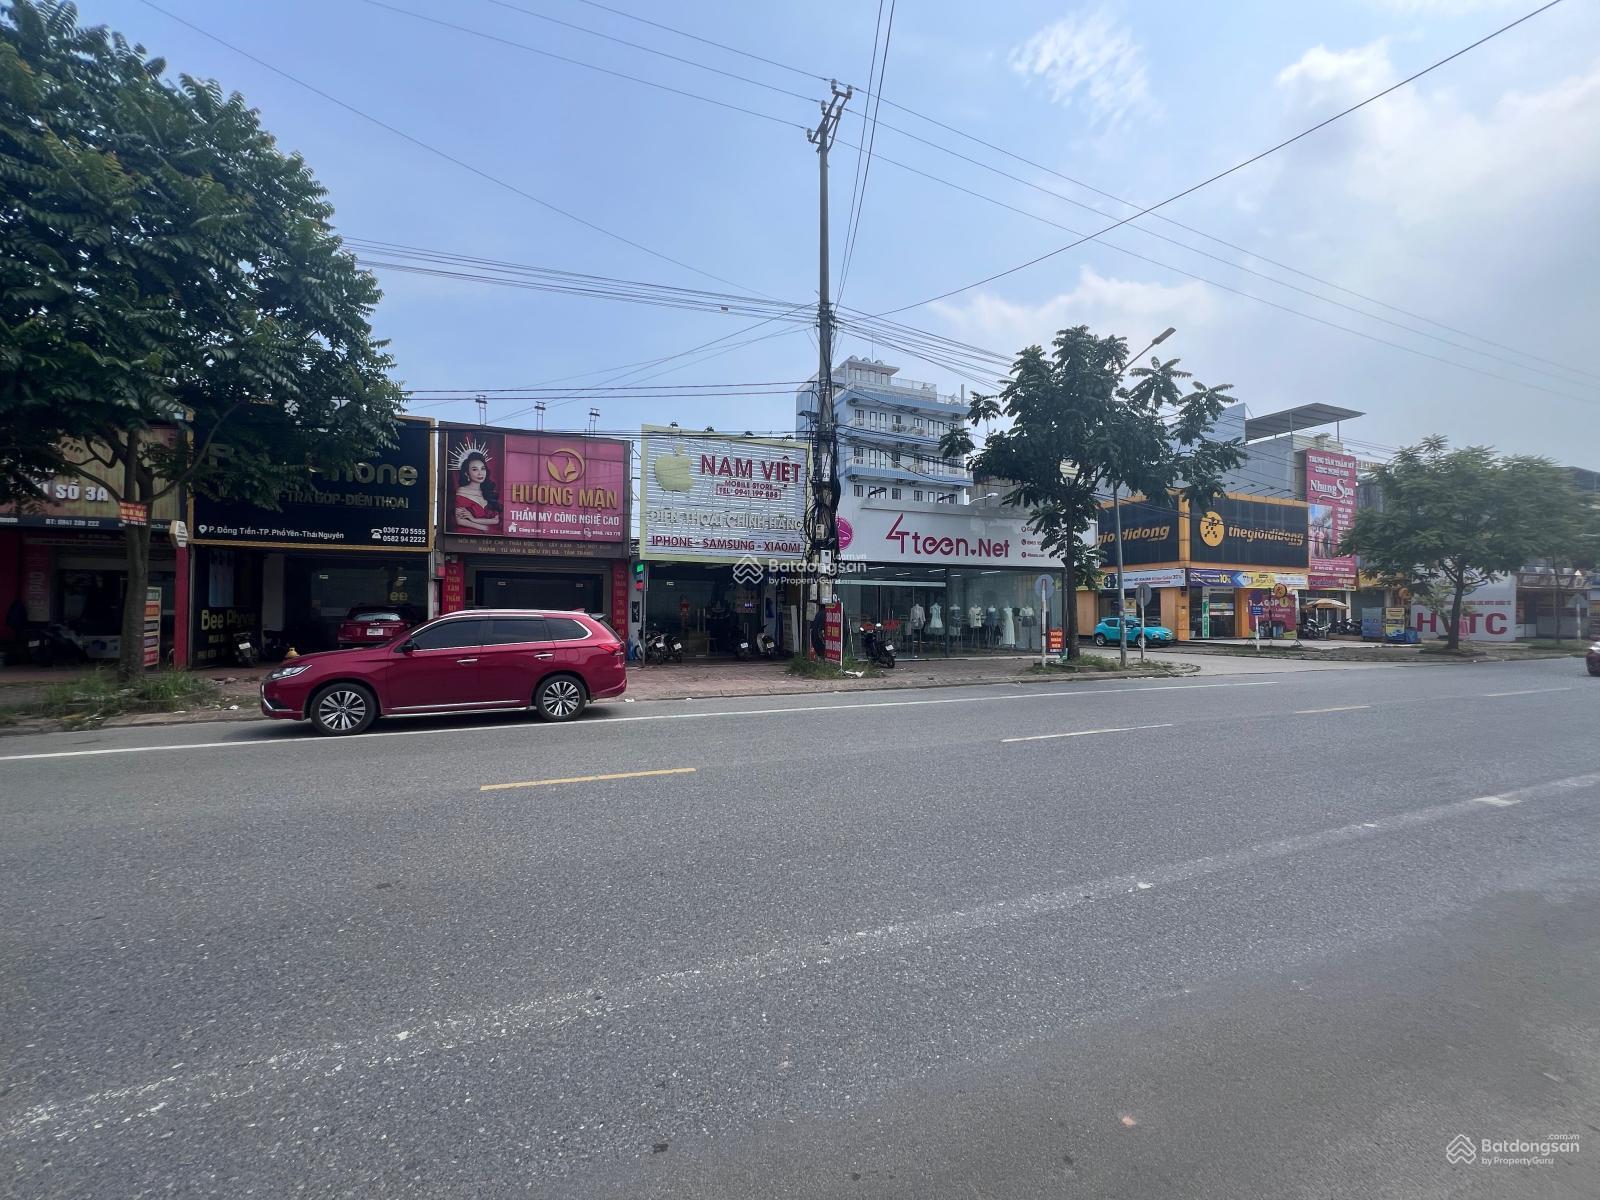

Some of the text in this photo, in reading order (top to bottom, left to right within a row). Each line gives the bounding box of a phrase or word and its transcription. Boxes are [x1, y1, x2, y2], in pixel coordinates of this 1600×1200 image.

[701, 455, 801, 487] NAM VIỆT
[55, 479, 80, 499] SỐ
[86, 486, 109, 501] 3A
[511, 483, 618, 511] HƯƠNG MẬN
[1311, 479, 1354, 499] Nhung Spa
[511, 507, 536, 522] THẨM
[554, 512, 577, 524] CÔNG
[579, 512, 601, 527] NGHỆ
[602, 516, 620, 526] CAO
[652, 535, 693, 547] IPHONE
[703, 538, 755, 550] SAMSUNG
[763, 541, 801, 552] XIAOMI
[201, 609, 224, 630] Bee
